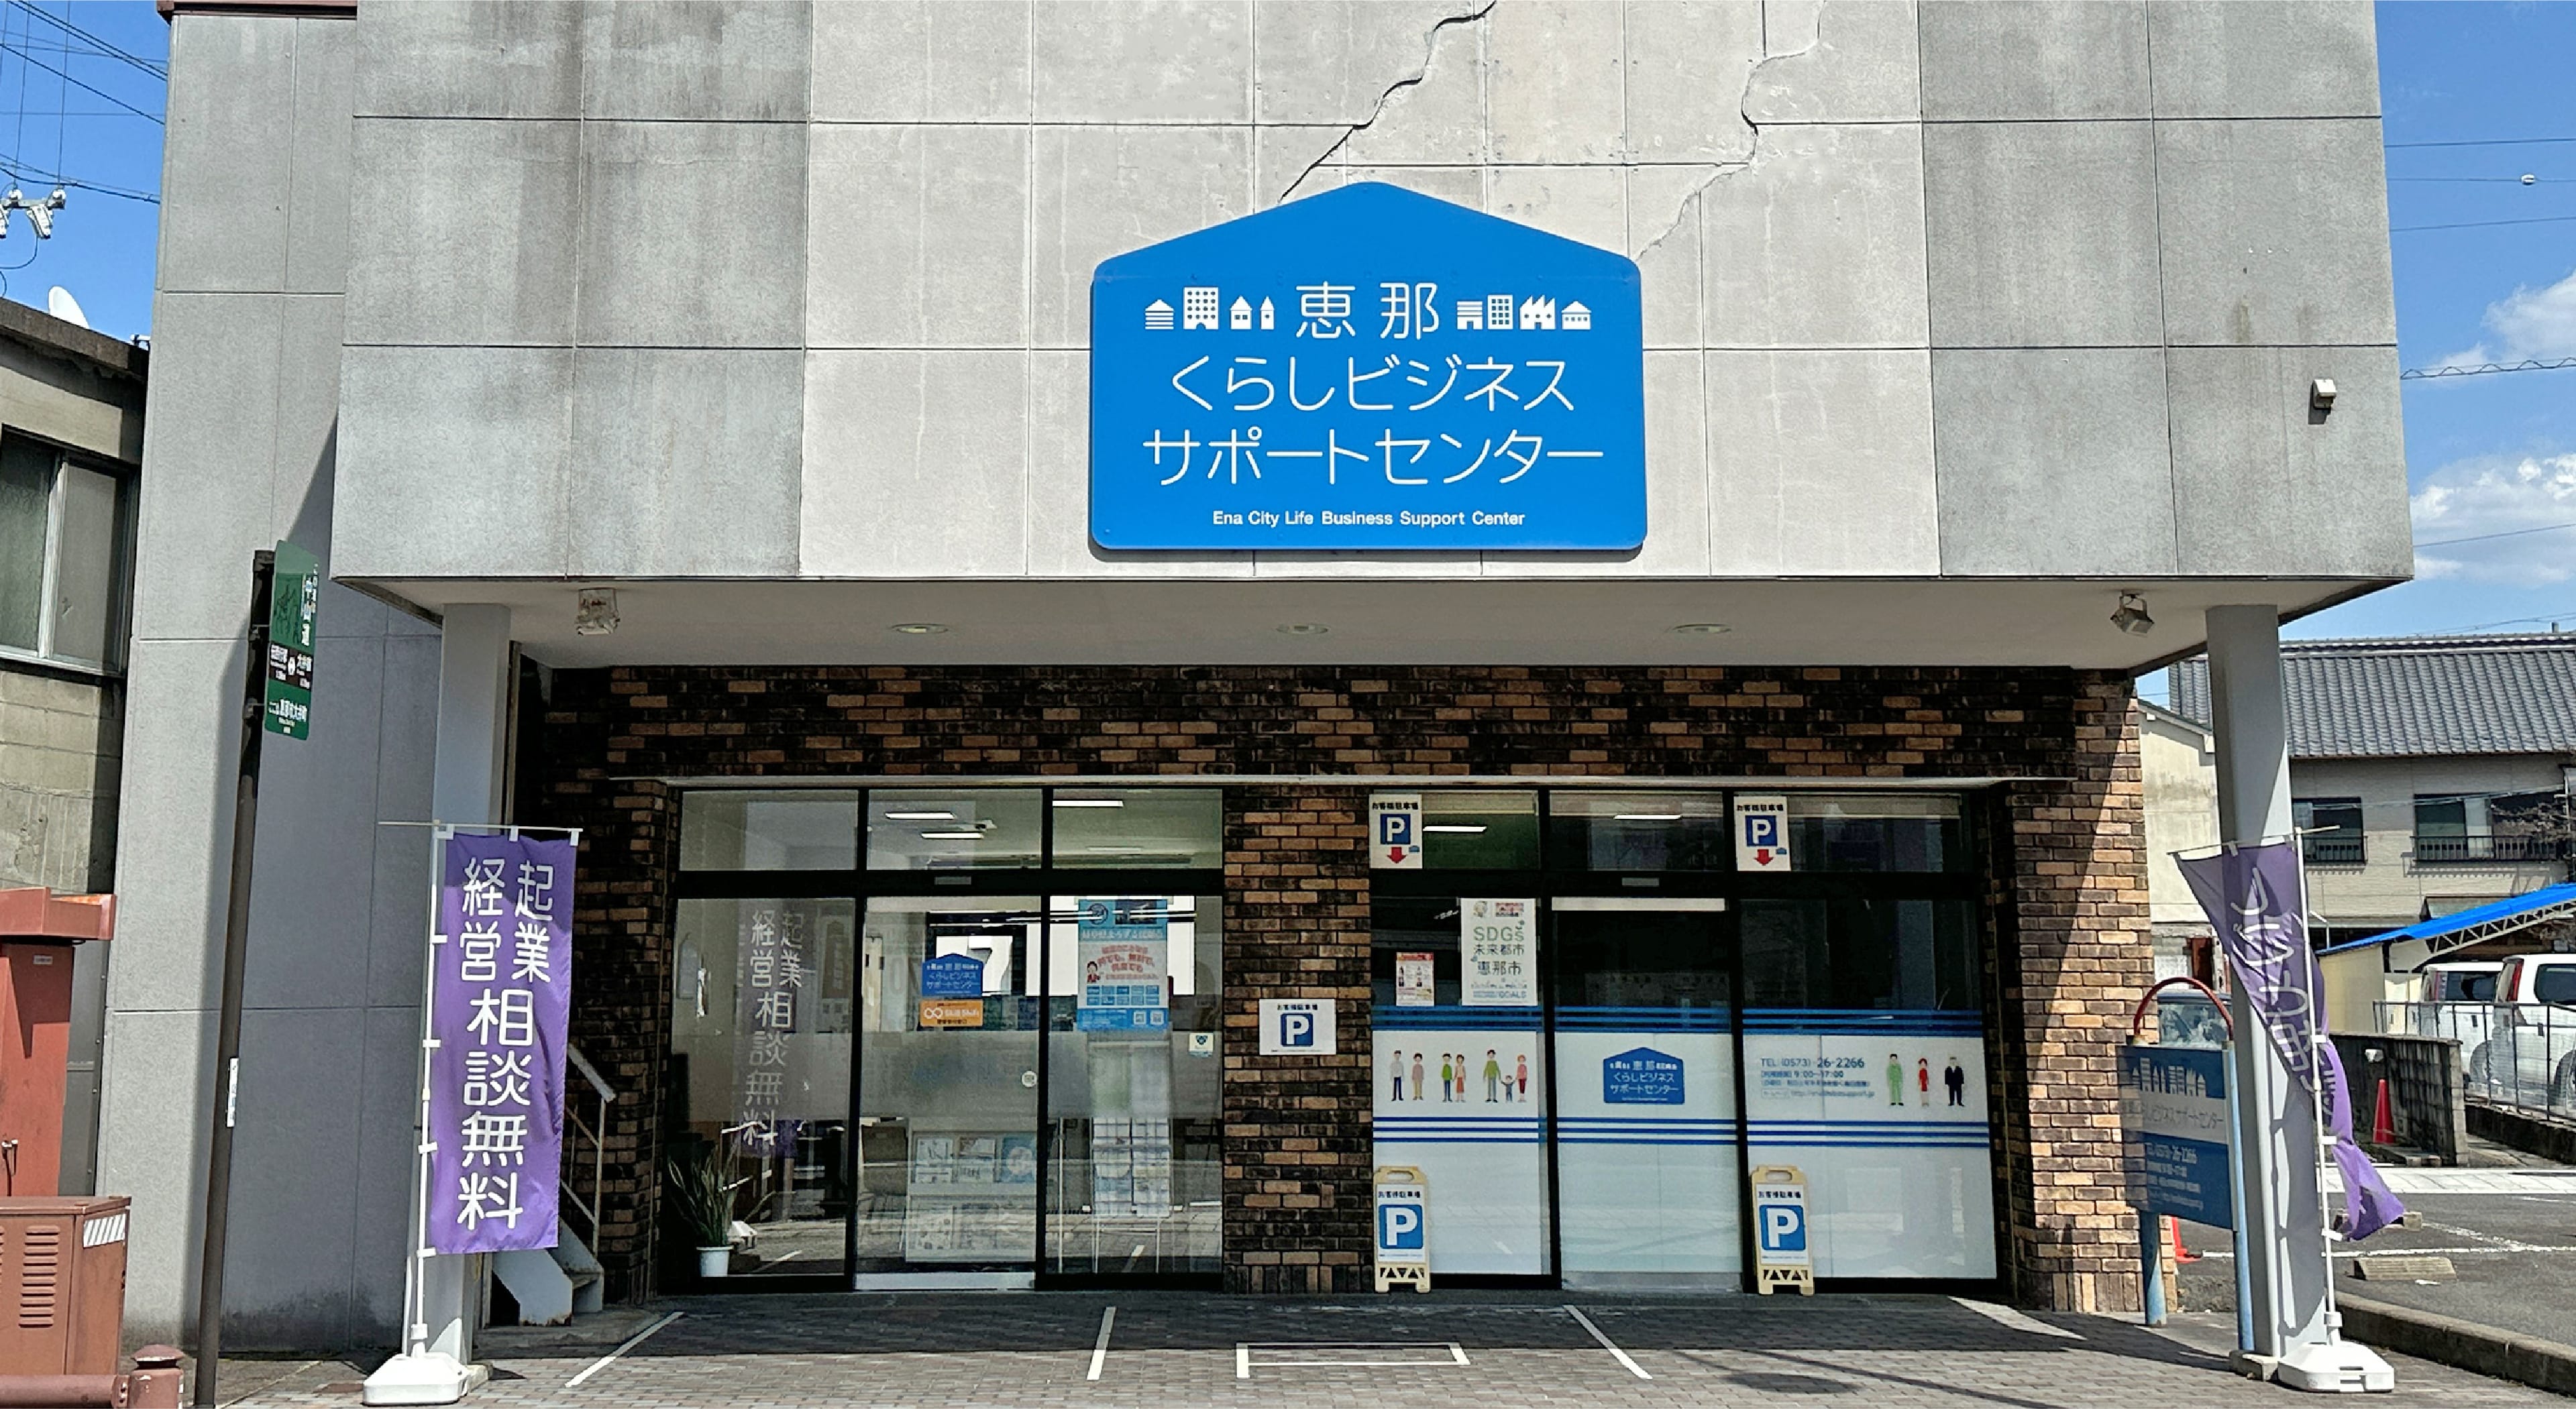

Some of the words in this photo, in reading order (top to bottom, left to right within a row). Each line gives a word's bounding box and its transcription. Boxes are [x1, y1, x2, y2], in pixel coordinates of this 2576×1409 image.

[1295, 281, 1440, 341] 恵那
[1172, 353, 1574, 411] くらしビジネス
[1142, 425, 1603, 486] サポートセンター
[1213, 511, 1243, 526] Ena
[1248, 510, 1280, 529] City
[1285, 510, 1314, 526] Life
[1322, 510, 1393, 526] Business
[1399, 510, 1465, 529] Support
[1472, 511, 1525, 526] Center
[1387, 817, 1405, 842] P
[1752, 819, 1772, 844] P
[460, 856, 506, 981] 経営
[512, 860, 553, 983] 起業
[1477, 961, 1522, 975] 恵那市
[1285, 1015, 1309, 1045] P
[1610, 1084, 1680, 1094] サポートセンター
[1613, 1072, 1675, 1082] くらしビジネス
[456, 989, 533, 1231] 相談無料
[1385, 1207, 1418, 1246] P
[1766, 1208, 1799, 1248] P
